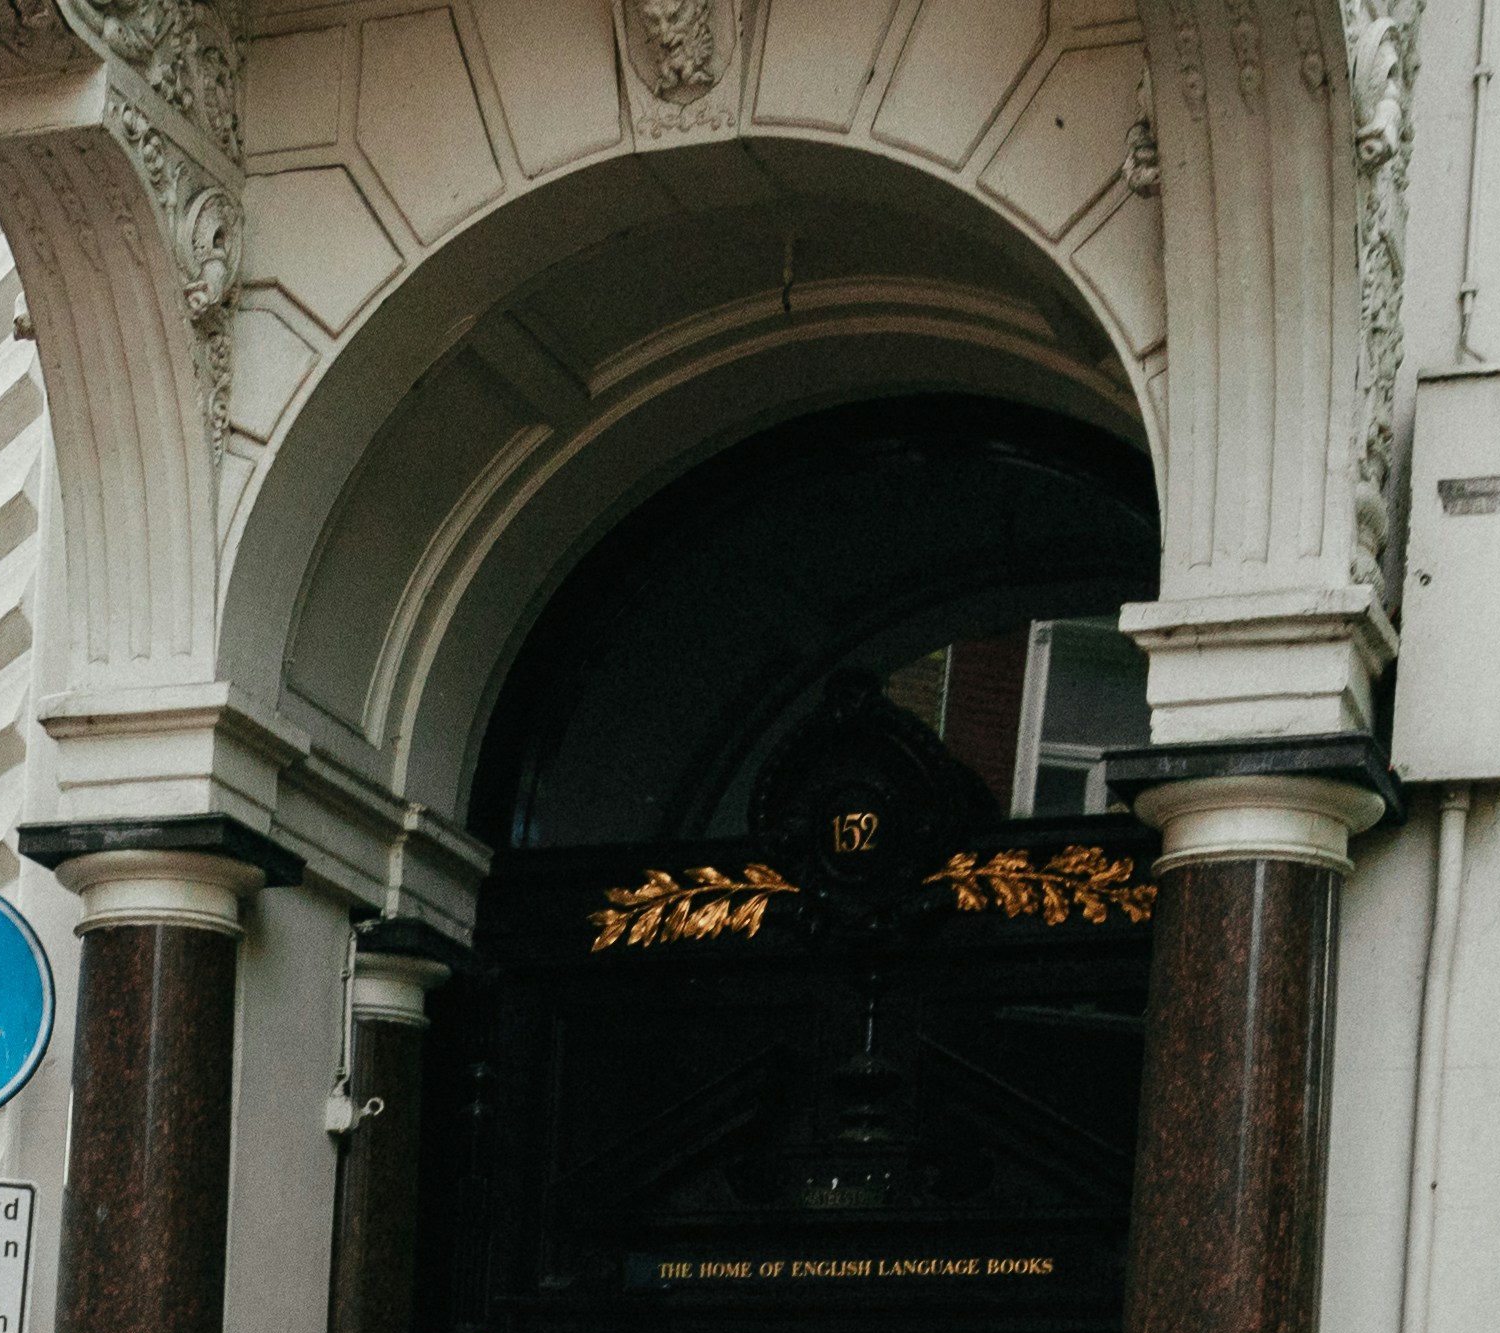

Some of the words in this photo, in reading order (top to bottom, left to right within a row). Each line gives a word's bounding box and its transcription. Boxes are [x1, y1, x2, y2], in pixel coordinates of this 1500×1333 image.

[833, 812, 878, 852] 152
[658, 1262, 693, 1279] THE
[699, 1261, 752, 1278] HOME
[759, 1261, 785, 1278] OF
[791, 1260, 872, 1278] ENGLISH
[878, 1258, 979, 1277] LANGUAGE
[986, 1257, 1054, 1275] BOOKS
